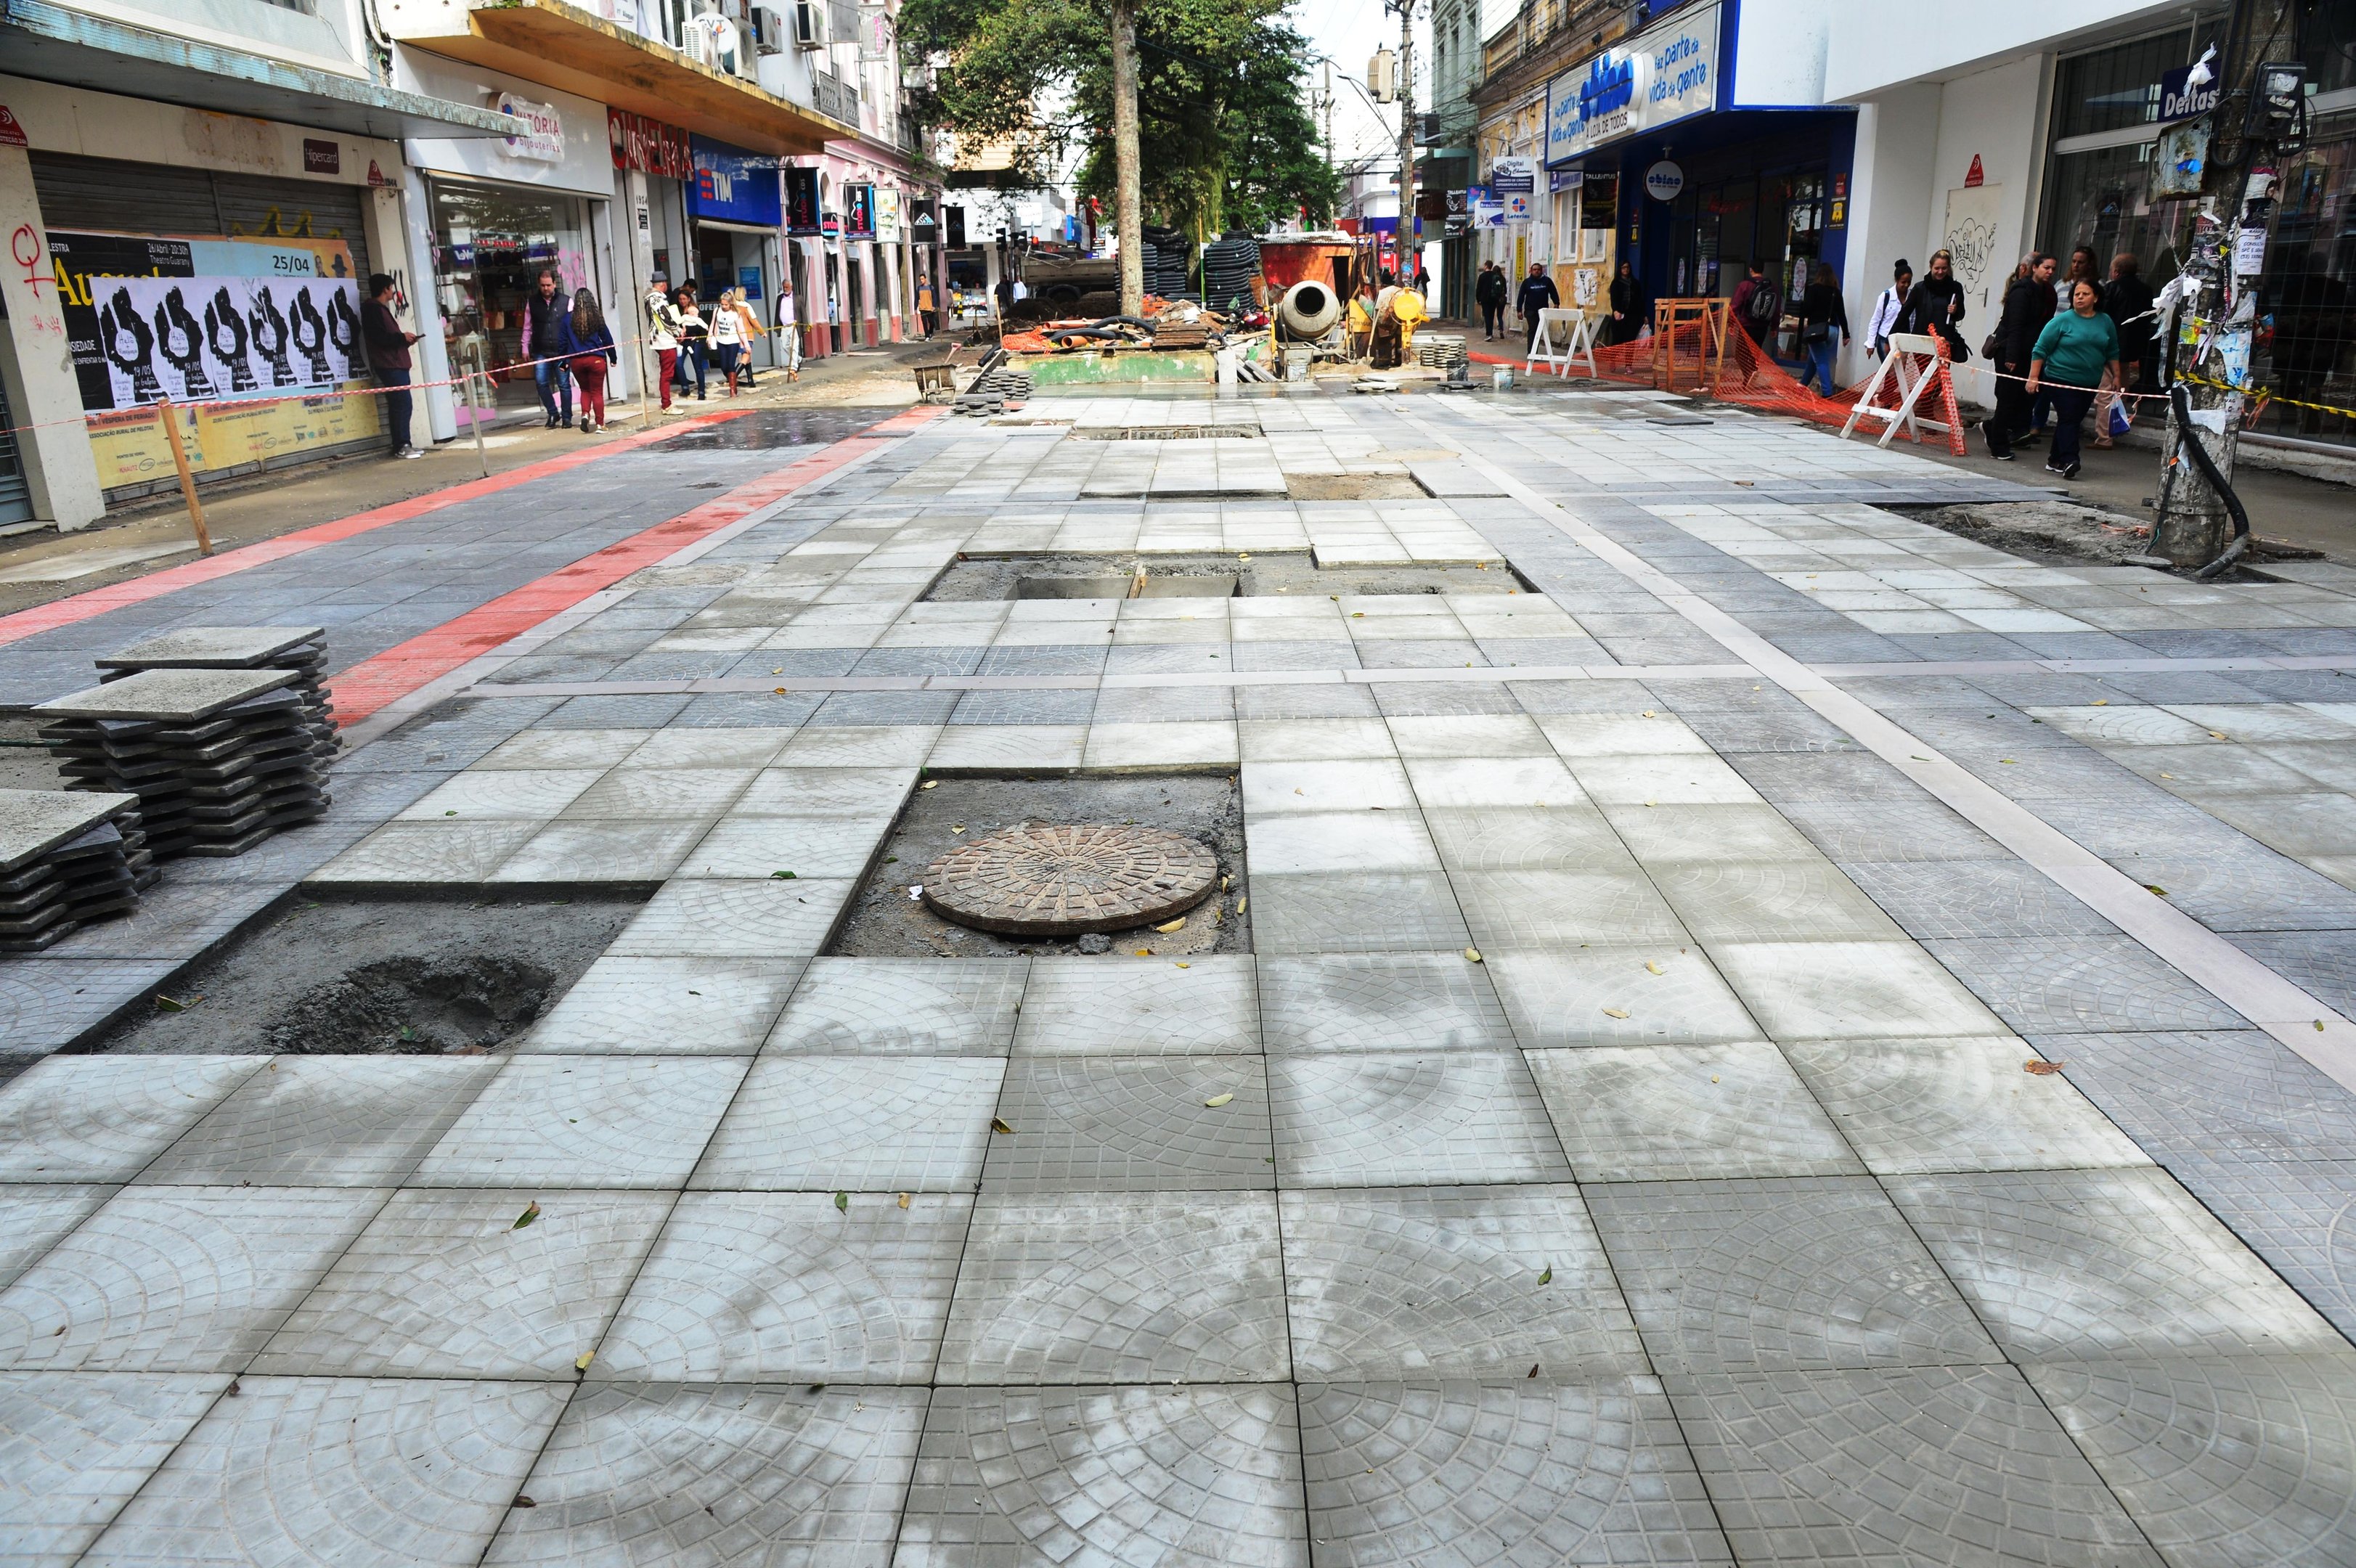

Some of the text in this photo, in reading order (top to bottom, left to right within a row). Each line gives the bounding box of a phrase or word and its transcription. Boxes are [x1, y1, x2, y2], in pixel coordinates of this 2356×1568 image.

[1655, 34, 1699, 74] faz parte da
[1649, 58, 1706, 105] vida da gente
[516, 110, 560, 136] ÓRIA
[1585, 111, 1628, 140] A LOJA DE TODOS
[305, 147, 338, 165] Hipercard
[519, 137, 561, 153] bijouterias
[608, 108, 696, 181] CINEMA
[711, 171, 733, 203] TIM
[1648, 173, 1682, 186] obino
[272, 255, 310, 273] 25/04
